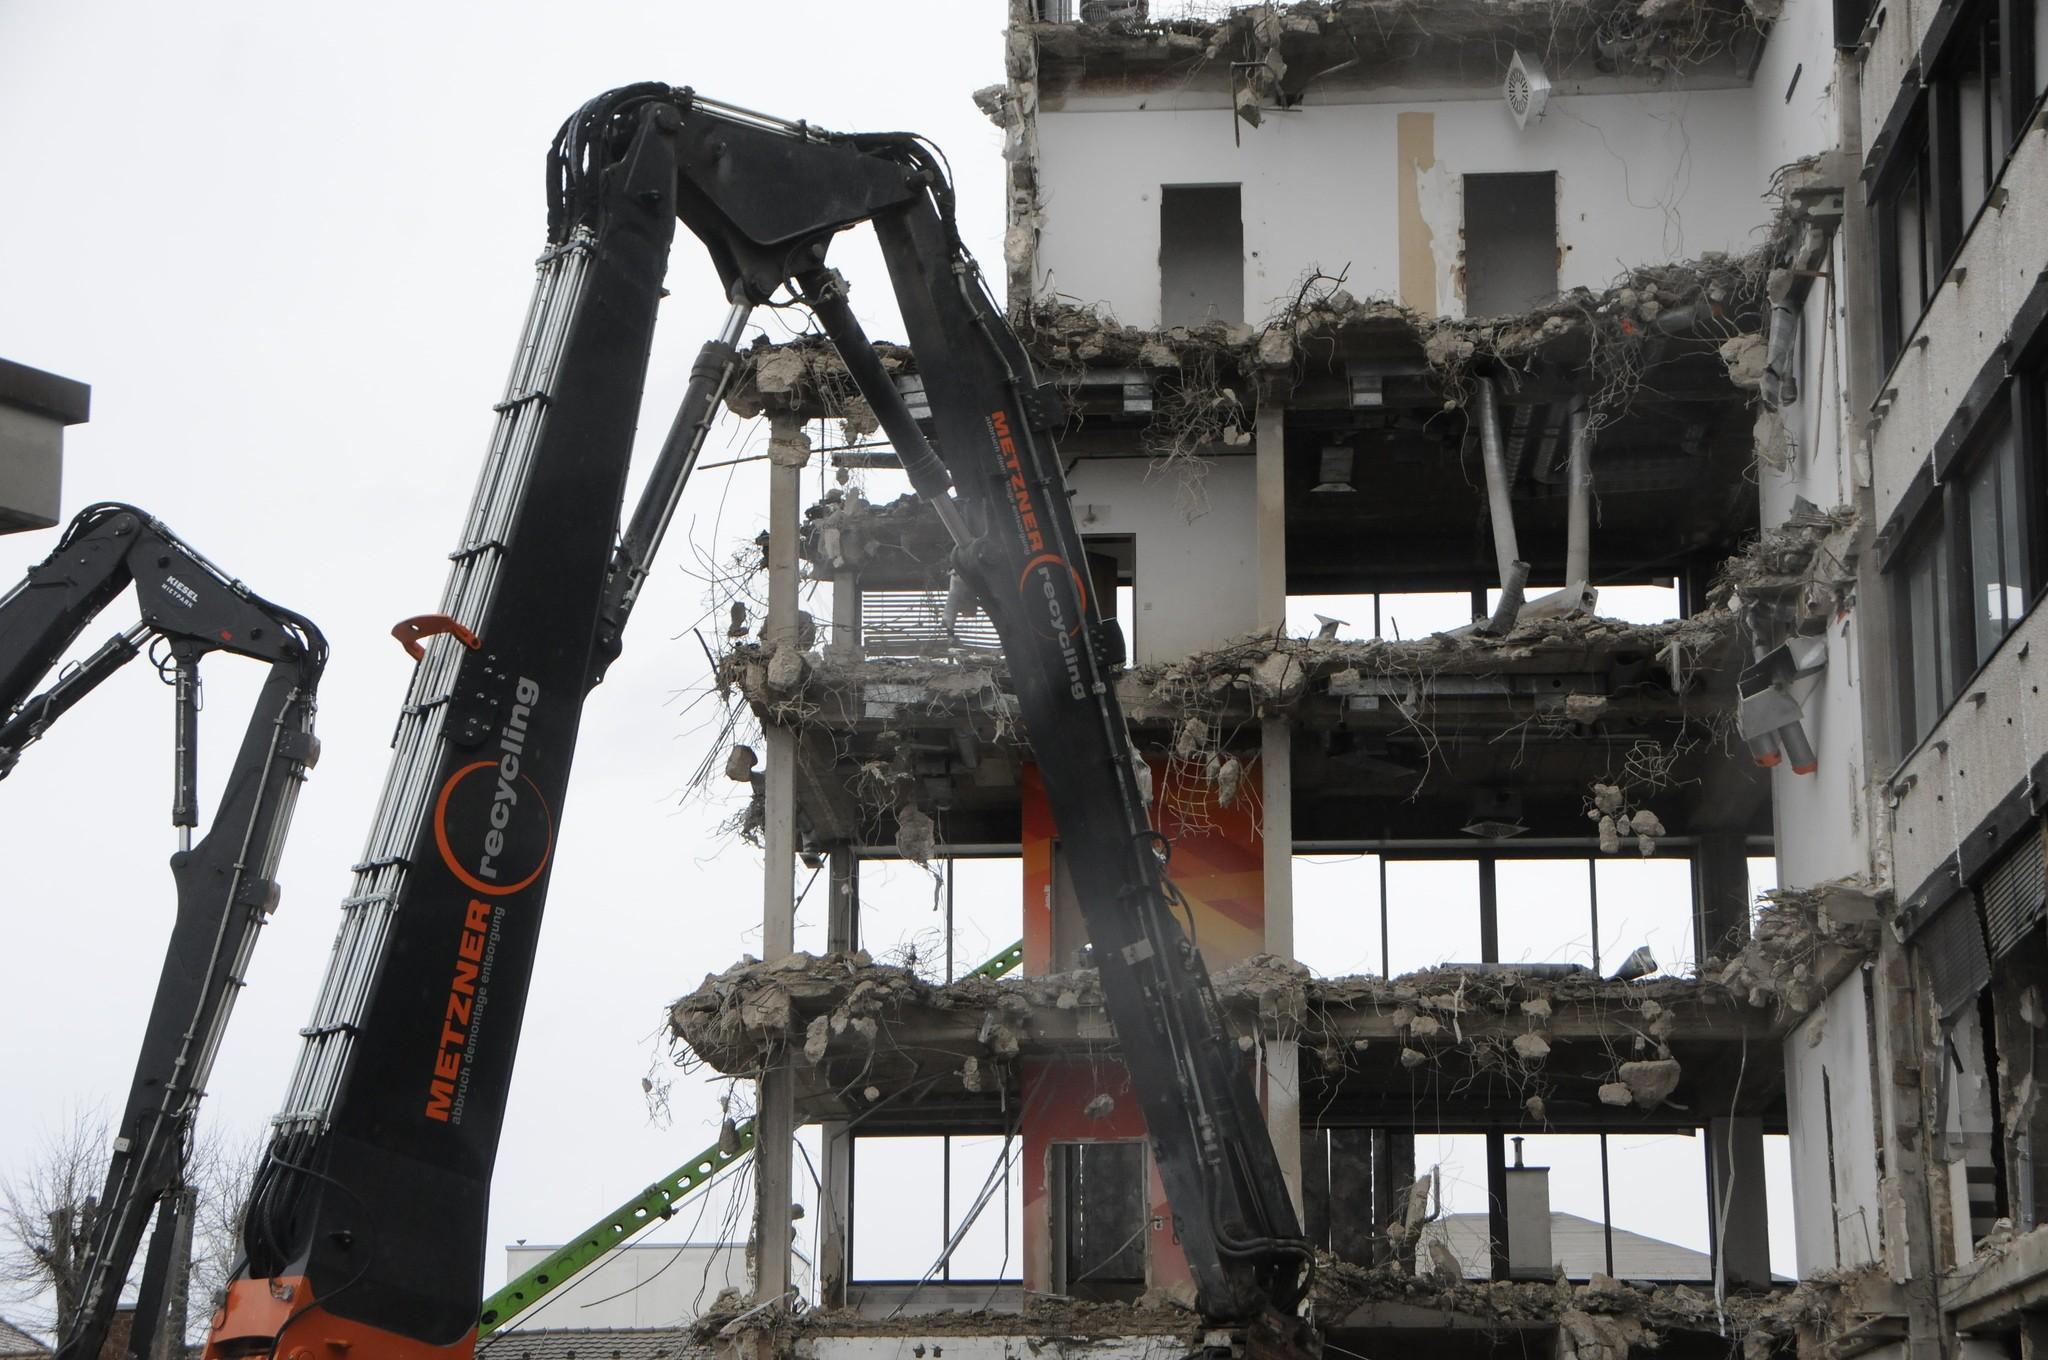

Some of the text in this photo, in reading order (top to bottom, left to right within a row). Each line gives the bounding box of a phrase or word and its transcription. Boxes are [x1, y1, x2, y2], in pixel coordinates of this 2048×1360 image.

[991, 410, 1044, 552] METZNER
[161, 583, 193, 609] MIETPARK
[166, 575, 198, 602] KIESEL
[1038, 567, 1087, 700] recycling
[480, 676, 540, 879] recycling
[425, 899, 491, 1122] METZNER
[452, 906, 506, 1125] abbruch demontage entsorgung
